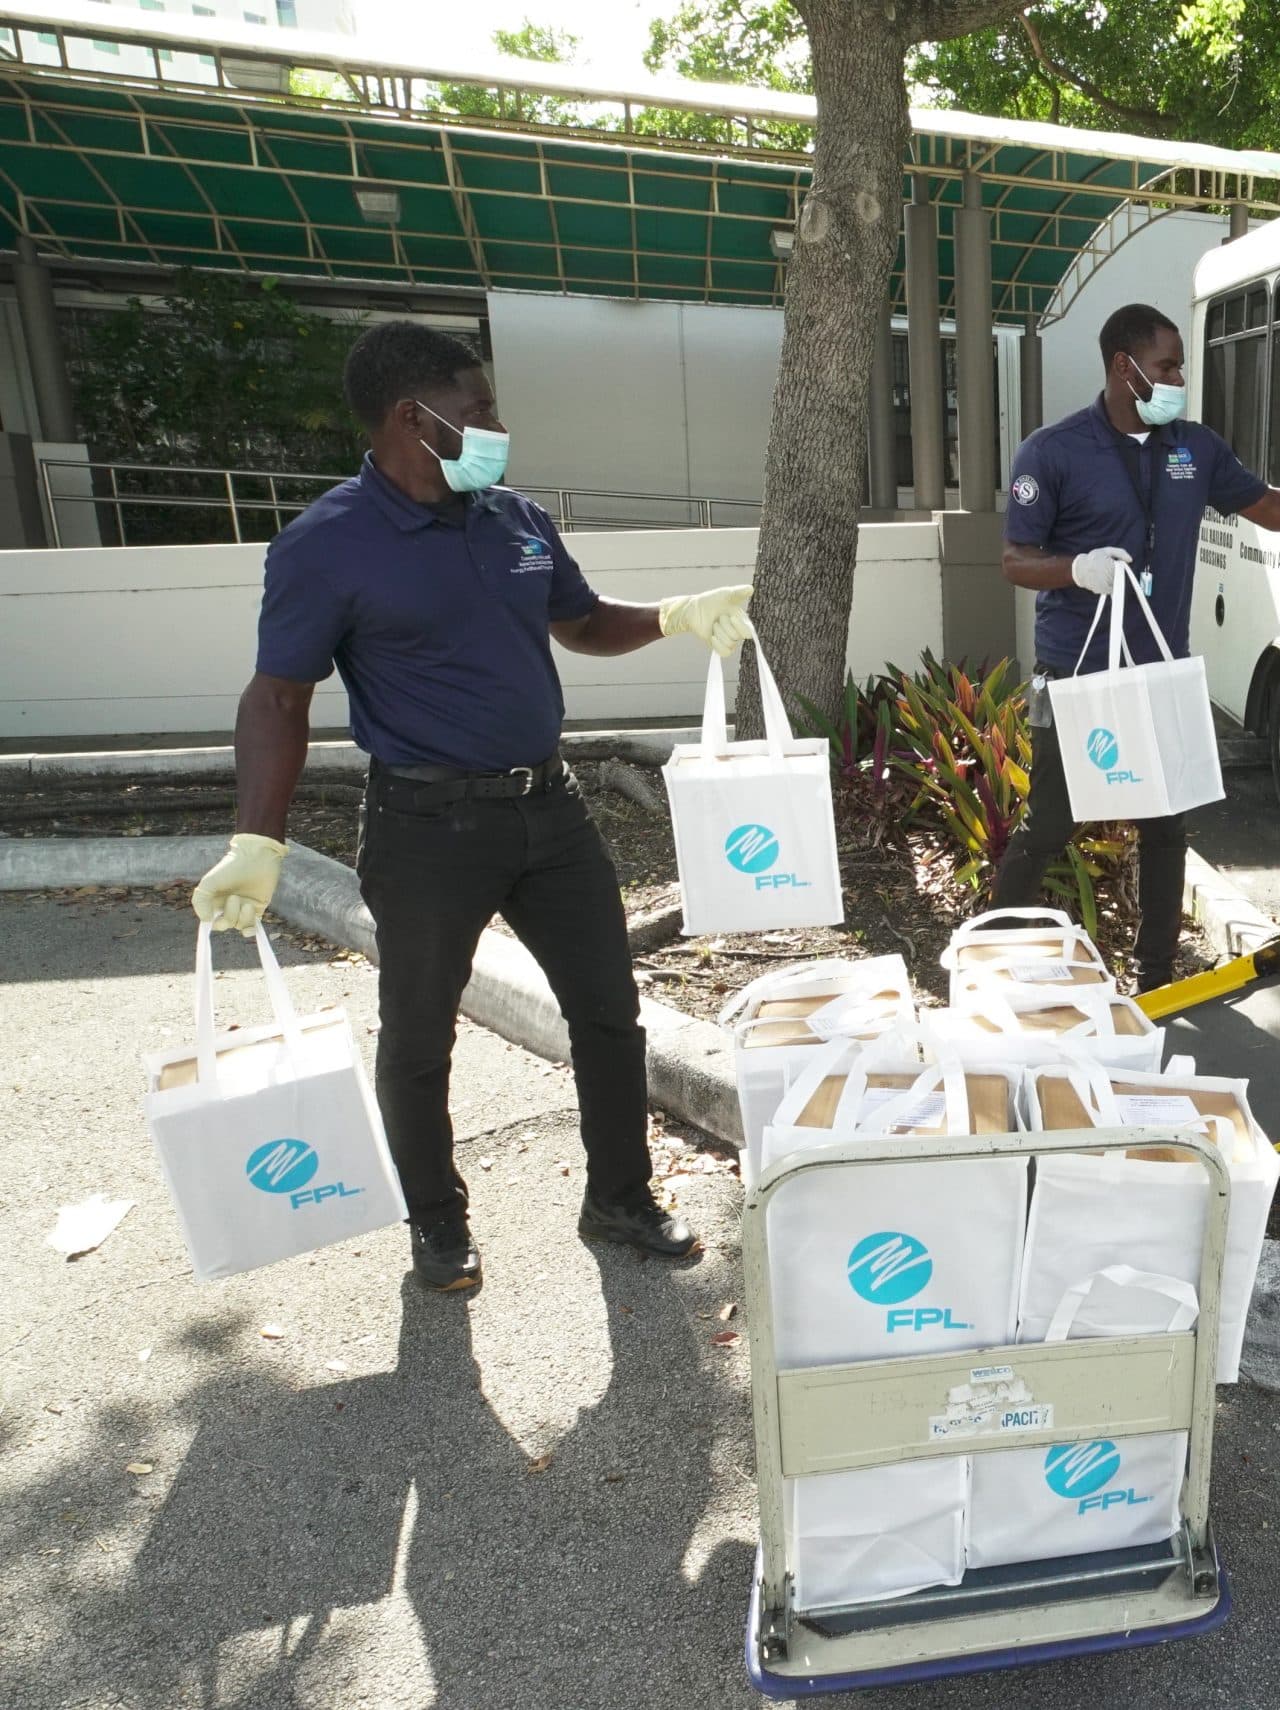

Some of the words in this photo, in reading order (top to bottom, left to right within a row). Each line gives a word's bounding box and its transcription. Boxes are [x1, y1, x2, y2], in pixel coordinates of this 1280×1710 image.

[1240, 541, 1276, 569] Community
[1106, 770, 1143, 784] FPL
[755, 873, 809, 890] FPL
[290, 1182, 361, 1210] FPL
[886, 1308, 969, 1333] FPL
[1078, 1488, 1150, 1515] FPL
